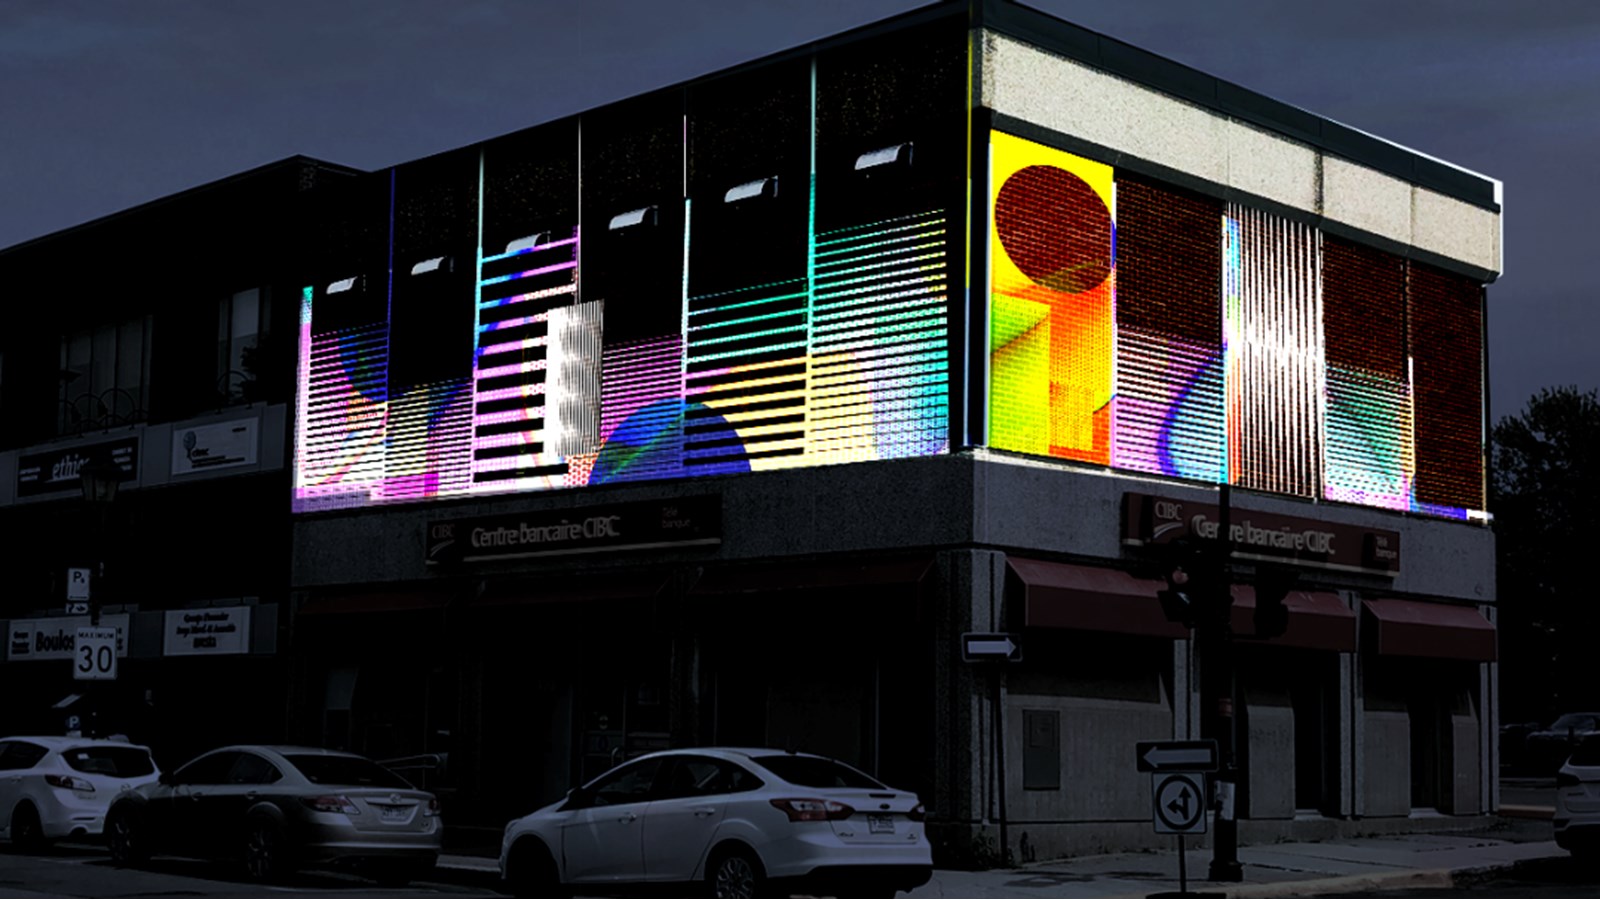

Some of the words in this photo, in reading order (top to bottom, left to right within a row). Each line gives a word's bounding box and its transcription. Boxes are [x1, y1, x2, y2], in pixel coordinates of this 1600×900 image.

[1154, 500, 1183, 521] CIBC
[431, 523, 456, 540] CIBC
[470, 526, 519, 549] Centre
[519, 519, 582, 544] bancaire
[582, 514, 622, 538] CIBC
[1243, 520, 1304, 551] bancaire
[1304, 529, 1337, 556] CIBC
[35, 629, 74, 652] Boulos
[78, 631, 115, 639] MAXIMUM
[78, 645, 113, 673] 30
